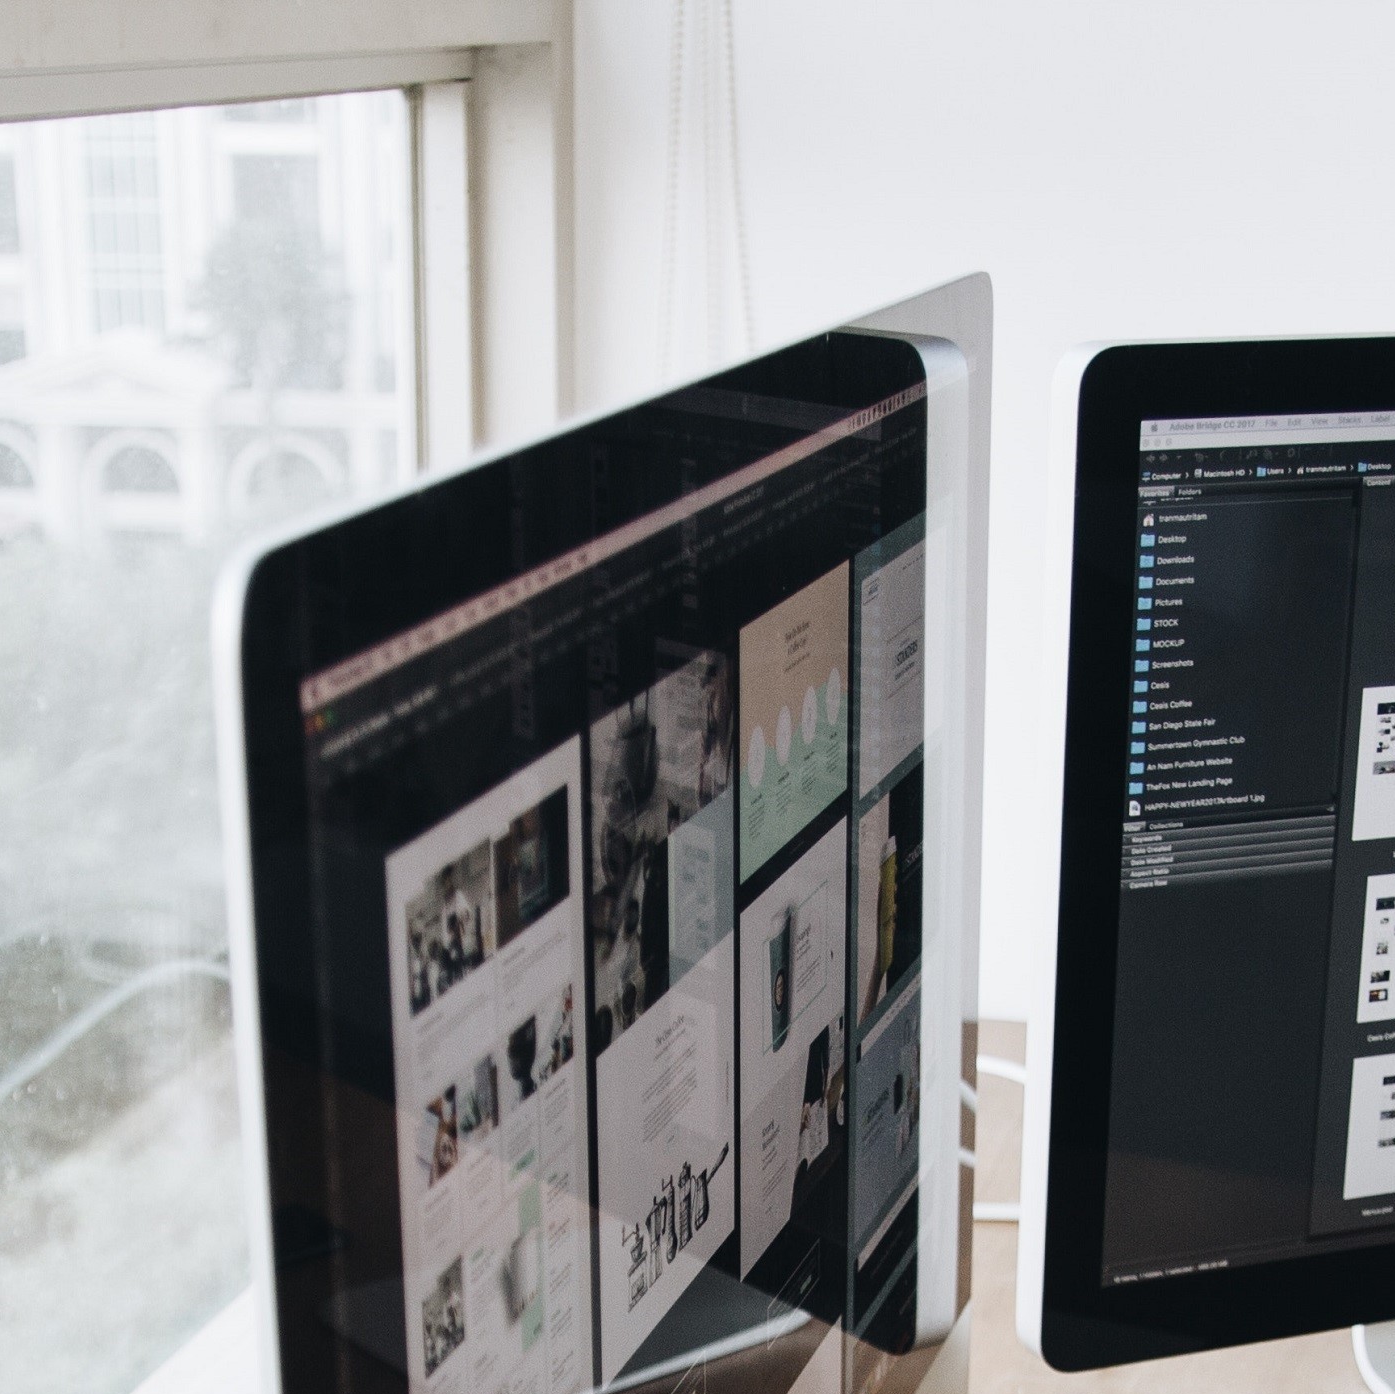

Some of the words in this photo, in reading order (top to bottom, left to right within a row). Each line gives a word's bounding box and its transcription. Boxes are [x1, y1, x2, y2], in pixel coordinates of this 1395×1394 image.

[1169, 421, 1193, 432] Adobe
[1195, 420, 1223, 432] Bridge
[1223, 420, 1237, 430] CC
[1237, 419, 1257, 429] 2017
[1370, 414, 1391, 424] Label
[1151, 472, 1183, 482] Computer
[1202, 469, 1235, 480] Macintosh
[1235, 469, 1247, 478] HD
[1266, 467, 1285, 476] Users
[1366, 461, 1392, 473] Desktop
[1178, 488, 1202, 497] Folders
[1157, 535, 1188, 545] Desktop
[1156, 555, 1195, 566] Downloads
[1155, 576, 1195, 587] Documents
[1154, 598, 1184, 607] Pictures
[1153, 618, 1180, 628] STOCK
[1152, 638, 1186, 649] MOCKUP
[1151, 659, 1195, 670] Screenshots
[1169, 700, 1193, 710] Coffee
[1148, 721, 1162, 732] San
[1162, 721, 1183, 731] Diego
[1184, 719, 1203, 729] State
[1203, 717, 1217, 727] Fair
[1147, 740, 1193, 752] Summertown
[1192, 737, 1228, 748] Gymnastic
[1228, 735, 1246, 745] Club
[1146, 763, 1157, 772] An
[1157, 762, 1174, 771] Nam
[1174, 759, 1205, 769] Furniture
[1205, 757, 1233, 767] Website
[1146, 782, 1171, 792] TheFox
[1171, 781, 1187, 789] New
[1187, 778, 1215, 789] Landing
[1215, 776, 1234, 787] Page
[1148, 820, 1184, 832] Collections
